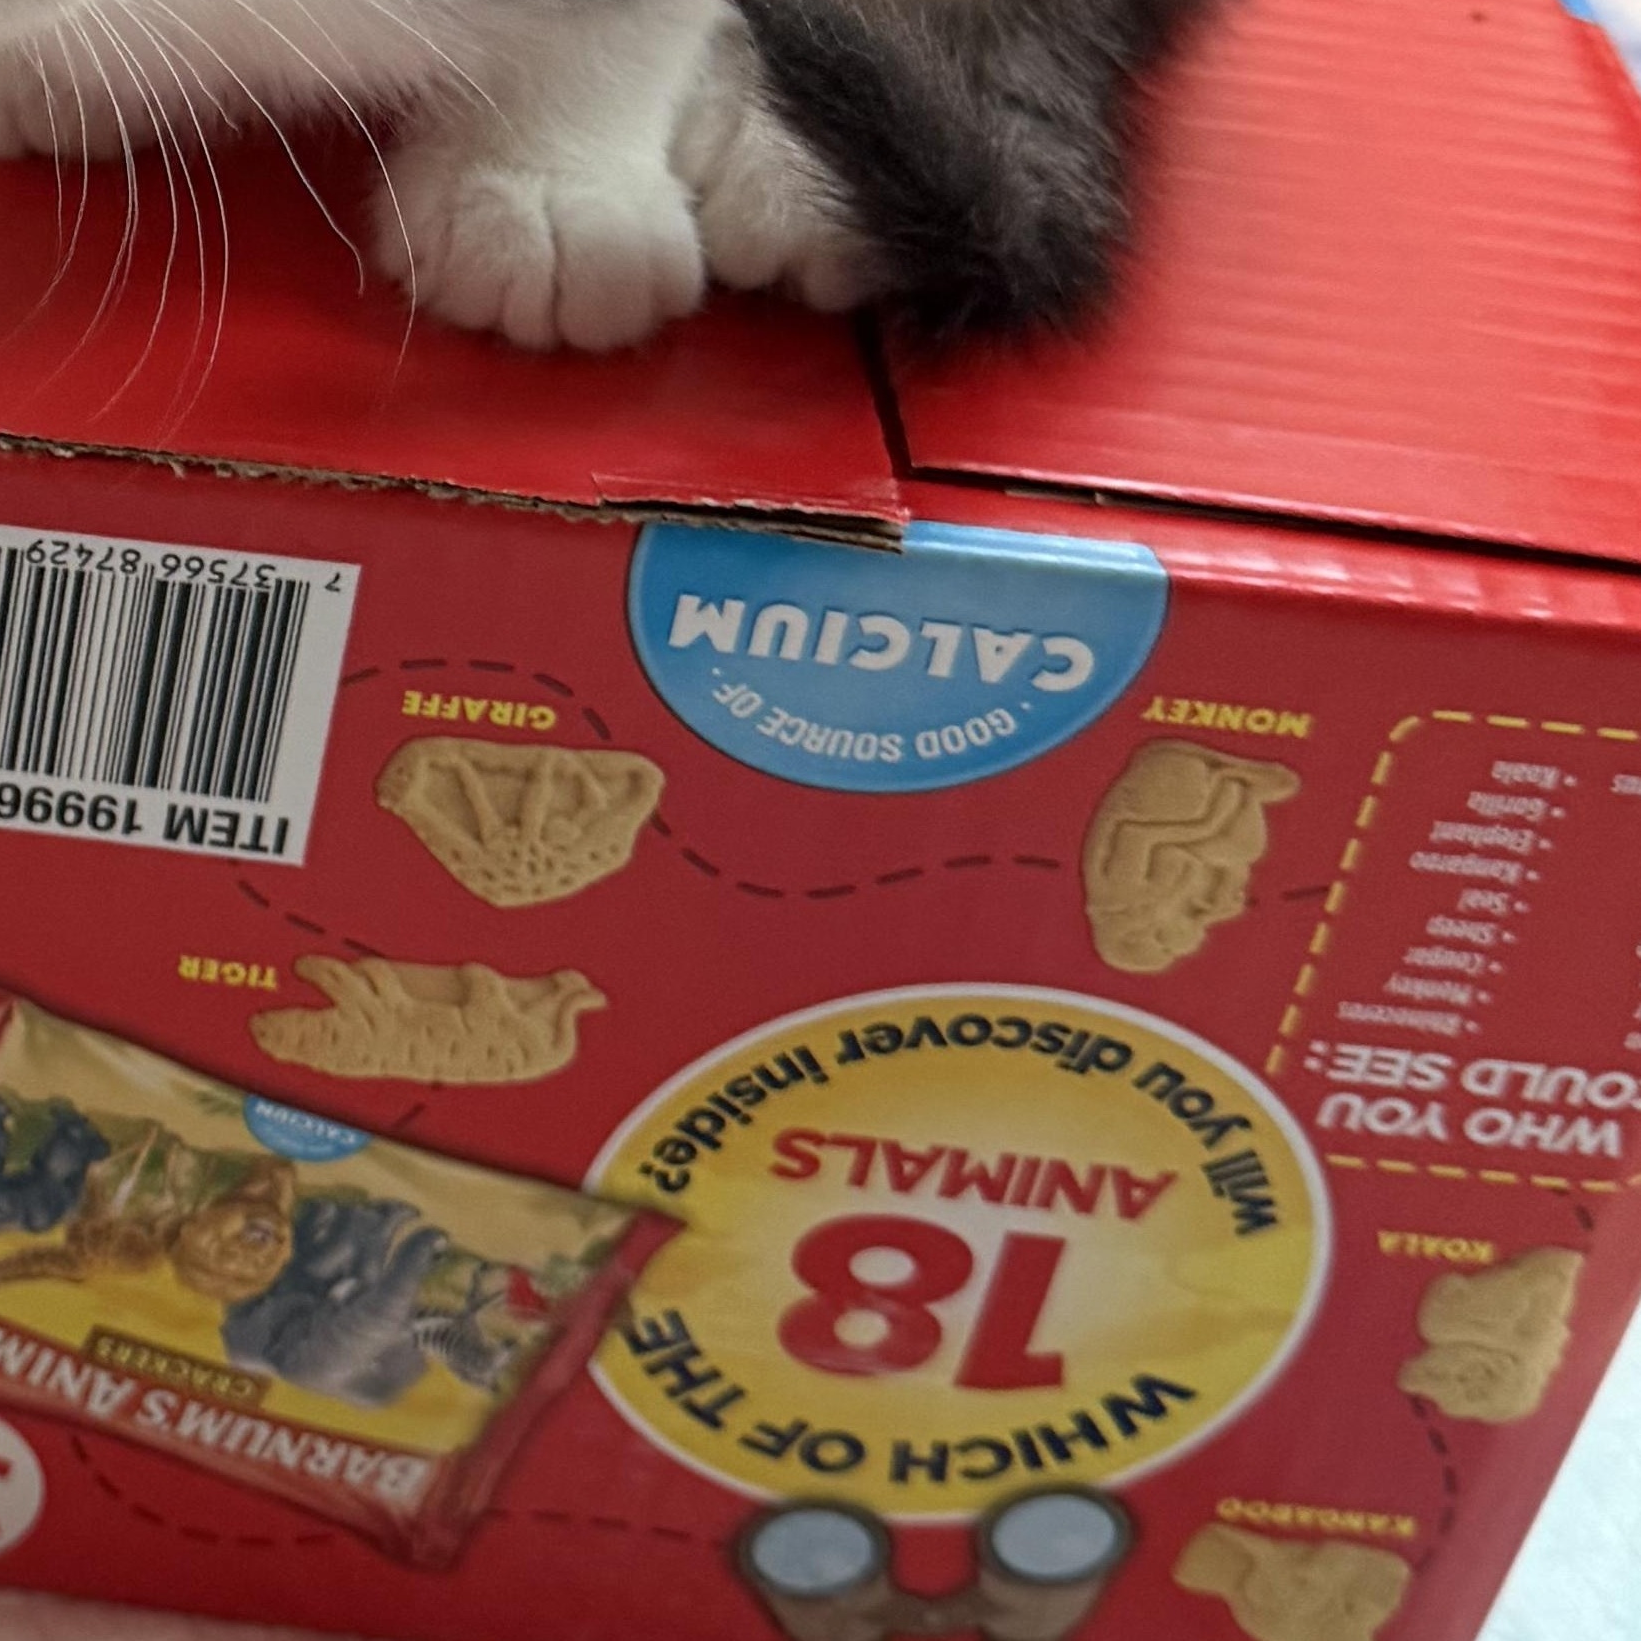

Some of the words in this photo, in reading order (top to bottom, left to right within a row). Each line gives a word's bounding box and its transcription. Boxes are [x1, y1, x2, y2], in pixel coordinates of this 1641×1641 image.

[27, 540, 140, 574] 87429
[161, 554, 276, 589] 37566
[325, 572, 341, 591] 7
[668, 594, 1095, 692] CALCIUM
[402, 690, 557, 730] GIRAFFE
[712, 681, 764, 719] OF
[1142, 696, 1311, 738] MONKEY
[757, 706, 902, 762] SOURCE
[915, 707, 1017, 759] GOOD
[1491, 760, 1560, 790] Koala
[163, 804, 289, 856] ITEM
[1456, 887, 1510, 916] Seal
[178, 955, 278, 990] TIGER
[1383, 972, 1472, 1007] Monkey
[835, 1014, 1133, 1075] discover
[1304, 1041, 1455, 1091] SEE:
[1133, 1060, 1250, 1152] you
[1461, 1059, 1641, 1110] OULD
[637, 1047, 829, 1196] inside?
[1316, 1092, 1450, 1142] YOU
[1464, 1108, 1622, 1158] WHO
[769, 1127, 1177, 1222] ANIMALS
[1199, 1147, 1277, 1238] will
[1376, 1230, 1494, 1265] KOALA
[777, 1214, 1067, 1392] 18
[93, 1335, 257, 1402] CRACKERS
[621, 1308, 749, 1430] THE
[142, 1387, 431, 1504] BARNUM'S
[736, 1419, 866, 1474] OF
[891, 1372, 1196, 1484] WHICH
[1217, 1496, 1417, 1538] KANGAROO
